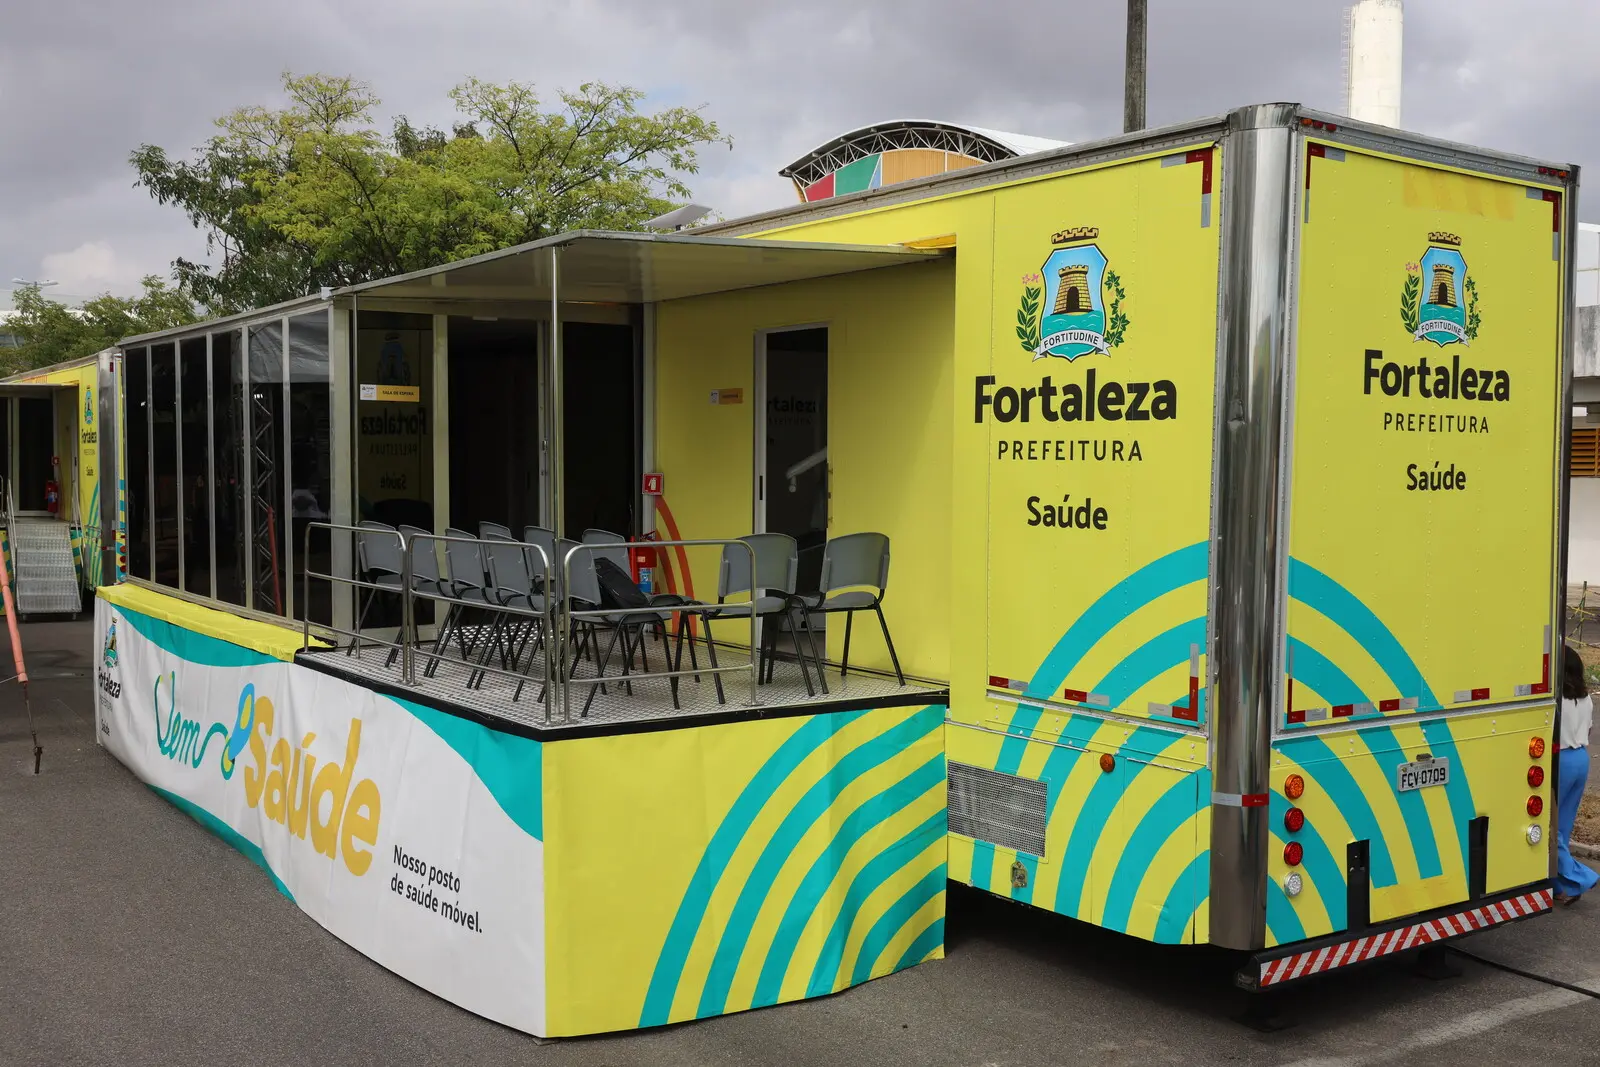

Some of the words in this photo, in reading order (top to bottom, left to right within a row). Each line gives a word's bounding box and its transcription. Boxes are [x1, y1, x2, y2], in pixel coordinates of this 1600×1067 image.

[1043, 331, 1100, 349] FORTITUDINE
[1421, 321, 1462, 336] FORTITUDINE
[1364, 348, 1509, 402] Fortaleza
[974, 367, 1177, 424] Fortaleza
[1383, 412, 1489, 434] PREFEITURA
[998, 439, 1142, 461] PREFEITURA
[1406, 460, 1467, 491] Saúde
[1027, 494, 1108, 530] Saúde
[155, 671, 214, 769] Vem
[244, 695, 381, 877] Saúde
[393, 844, 427, 877] Nosso
[428, 865, 461, 893] posto
[391, 872, 404, 896] de
[406, 883, 439, 913] saúde
[441, 900, 483, 934] móvel.
